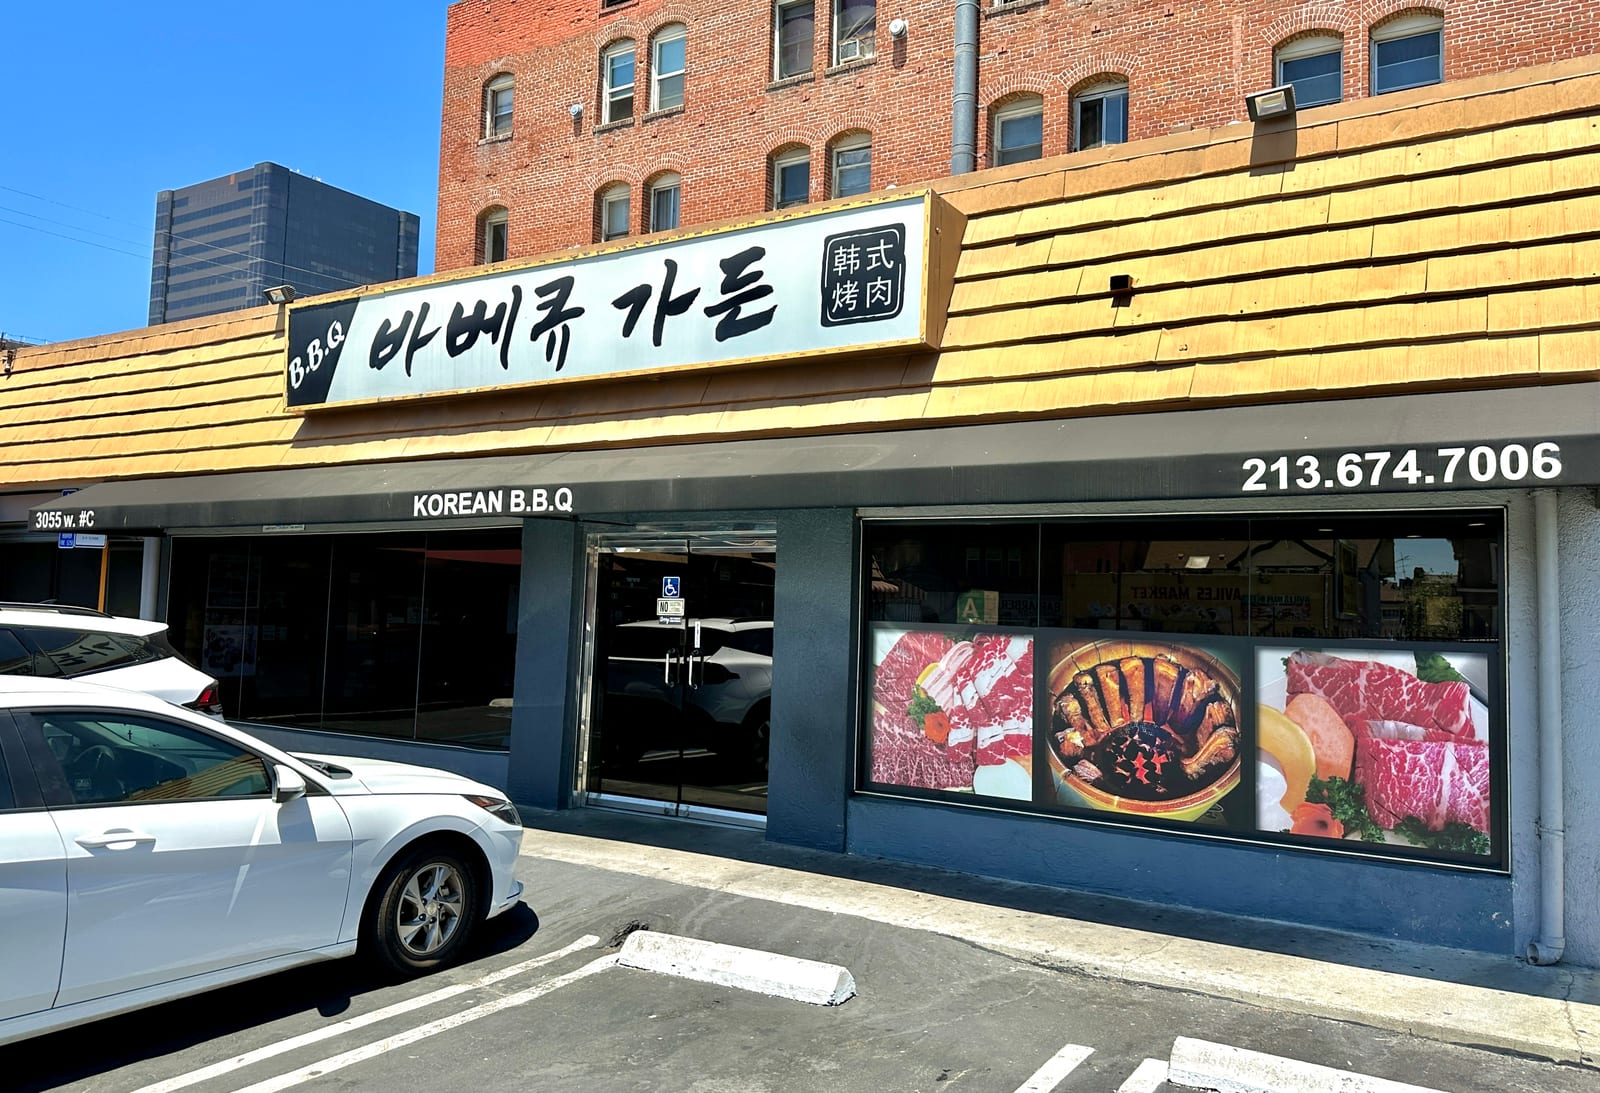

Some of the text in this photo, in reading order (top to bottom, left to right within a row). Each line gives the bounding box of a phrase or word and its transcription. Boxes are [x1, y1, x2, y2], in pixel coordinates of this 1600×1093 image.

[833, 239, 894, 276] 韩式
[368, 246, 779, 377] 바베큐 가든
[832, 276, 892, 313] 烤肉
[289, 320, 345, 390] B.B.Q
[1242, 442, 1562, 491] 213.674.7006
[35, 511, 62, 528] 3055
[79, 510, 95, 527] #C
[413, 487, 573, 517] KOREAN B.B.Q
[660, 601, 669, 612] NO
[961, 597, 979, 618] A
